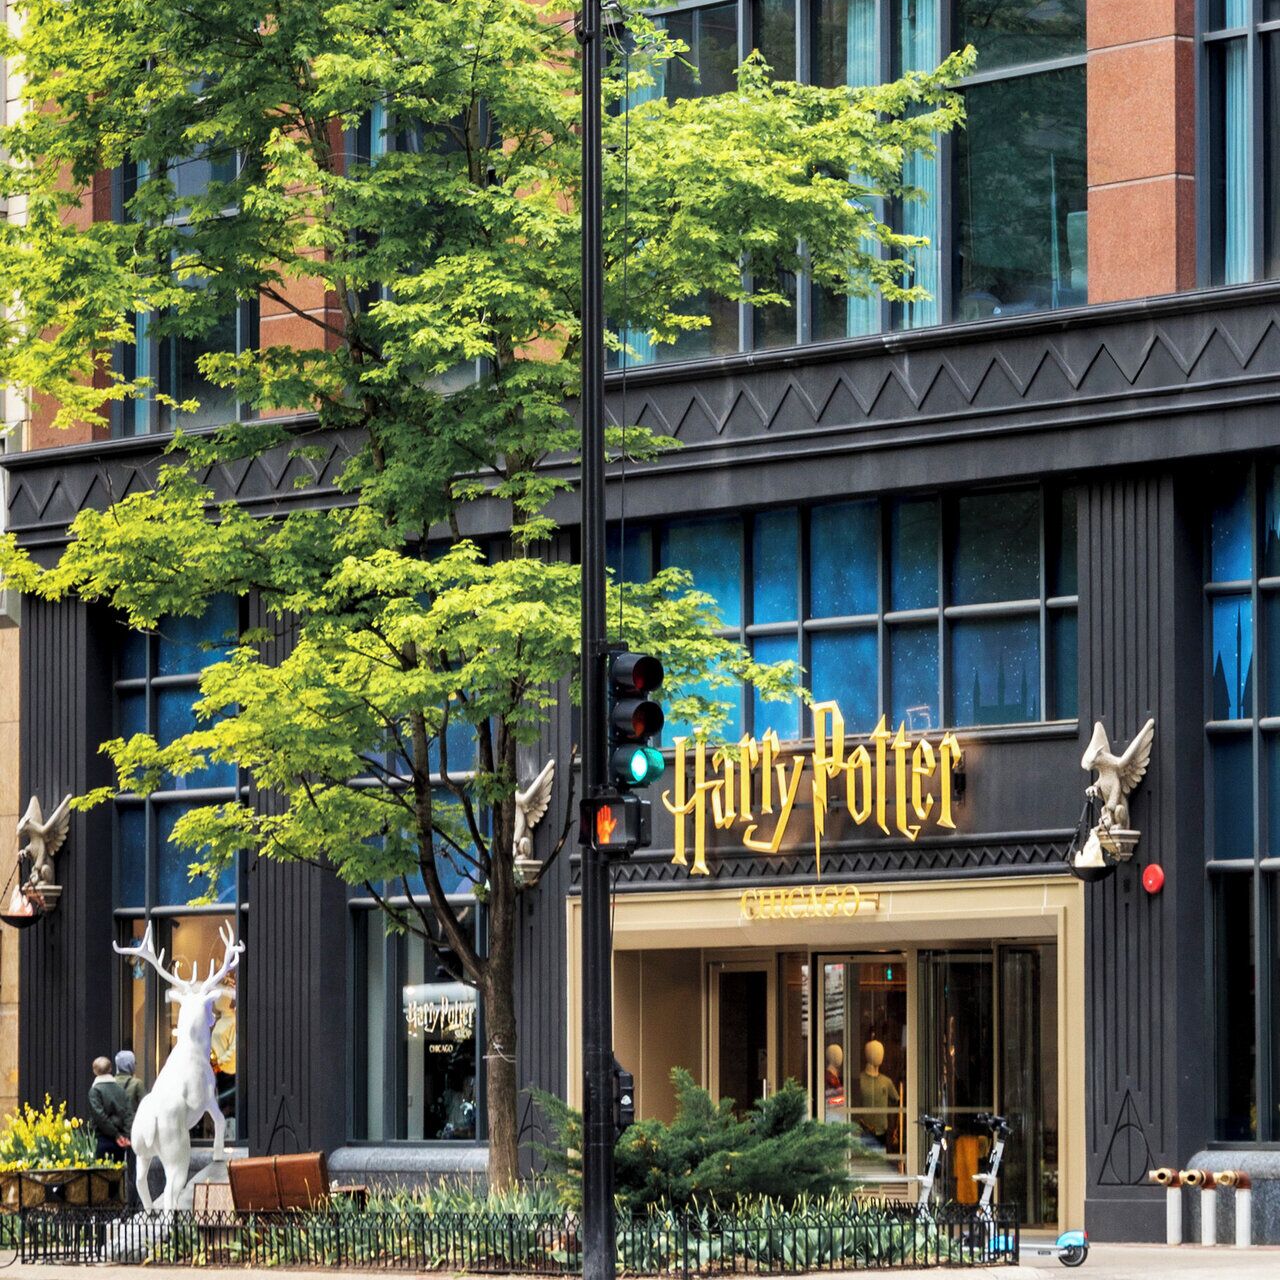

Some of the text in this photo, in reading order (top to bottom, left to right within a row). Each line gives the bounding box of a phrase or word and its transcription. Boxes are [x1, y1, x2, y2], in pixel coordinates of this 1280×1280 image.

[662, 700, 962, 882] Harry Potter
[741, 885, 861, 920] CHICAGO
[429, 1044, 454, 1054] CHICAGO
